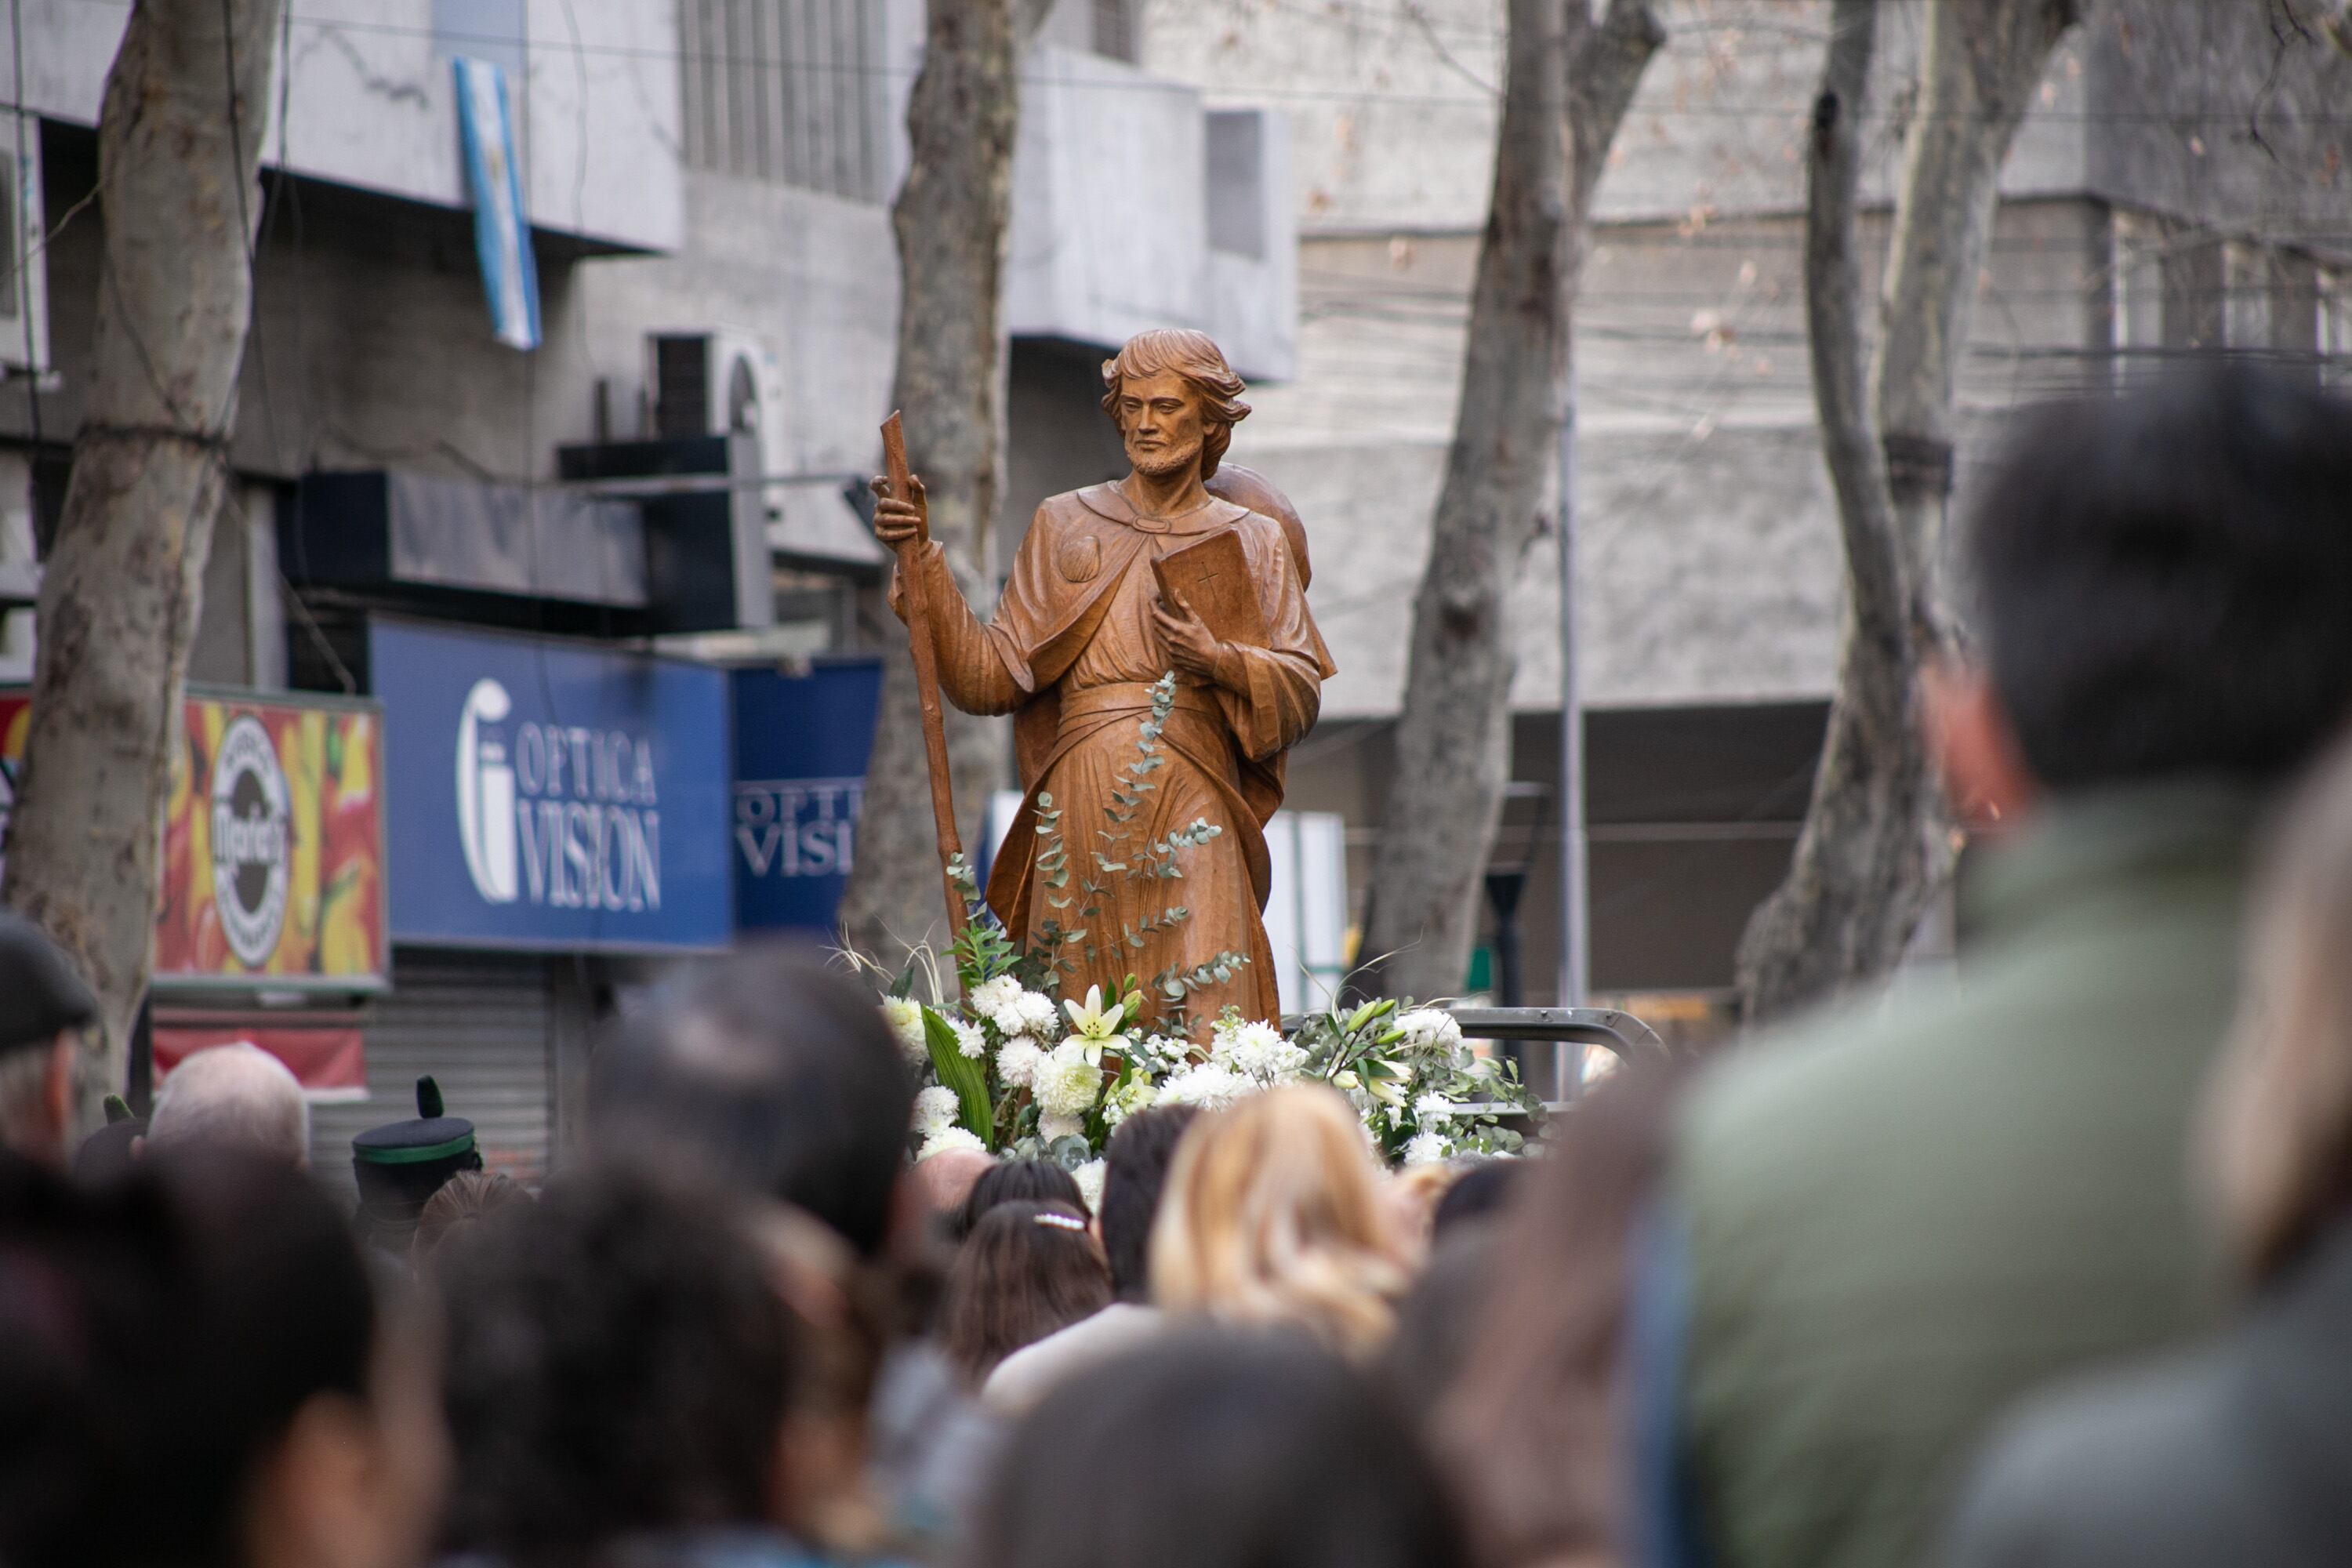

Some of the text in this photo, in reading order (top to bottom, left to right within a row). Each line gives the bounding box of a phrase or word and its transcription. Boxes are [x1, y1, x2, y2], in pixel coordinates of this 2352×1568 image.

[515, 722, 655, 807] OPTICA
[517, 798, 660, 913] VISION
[737, 821, 854, 878] VISI
